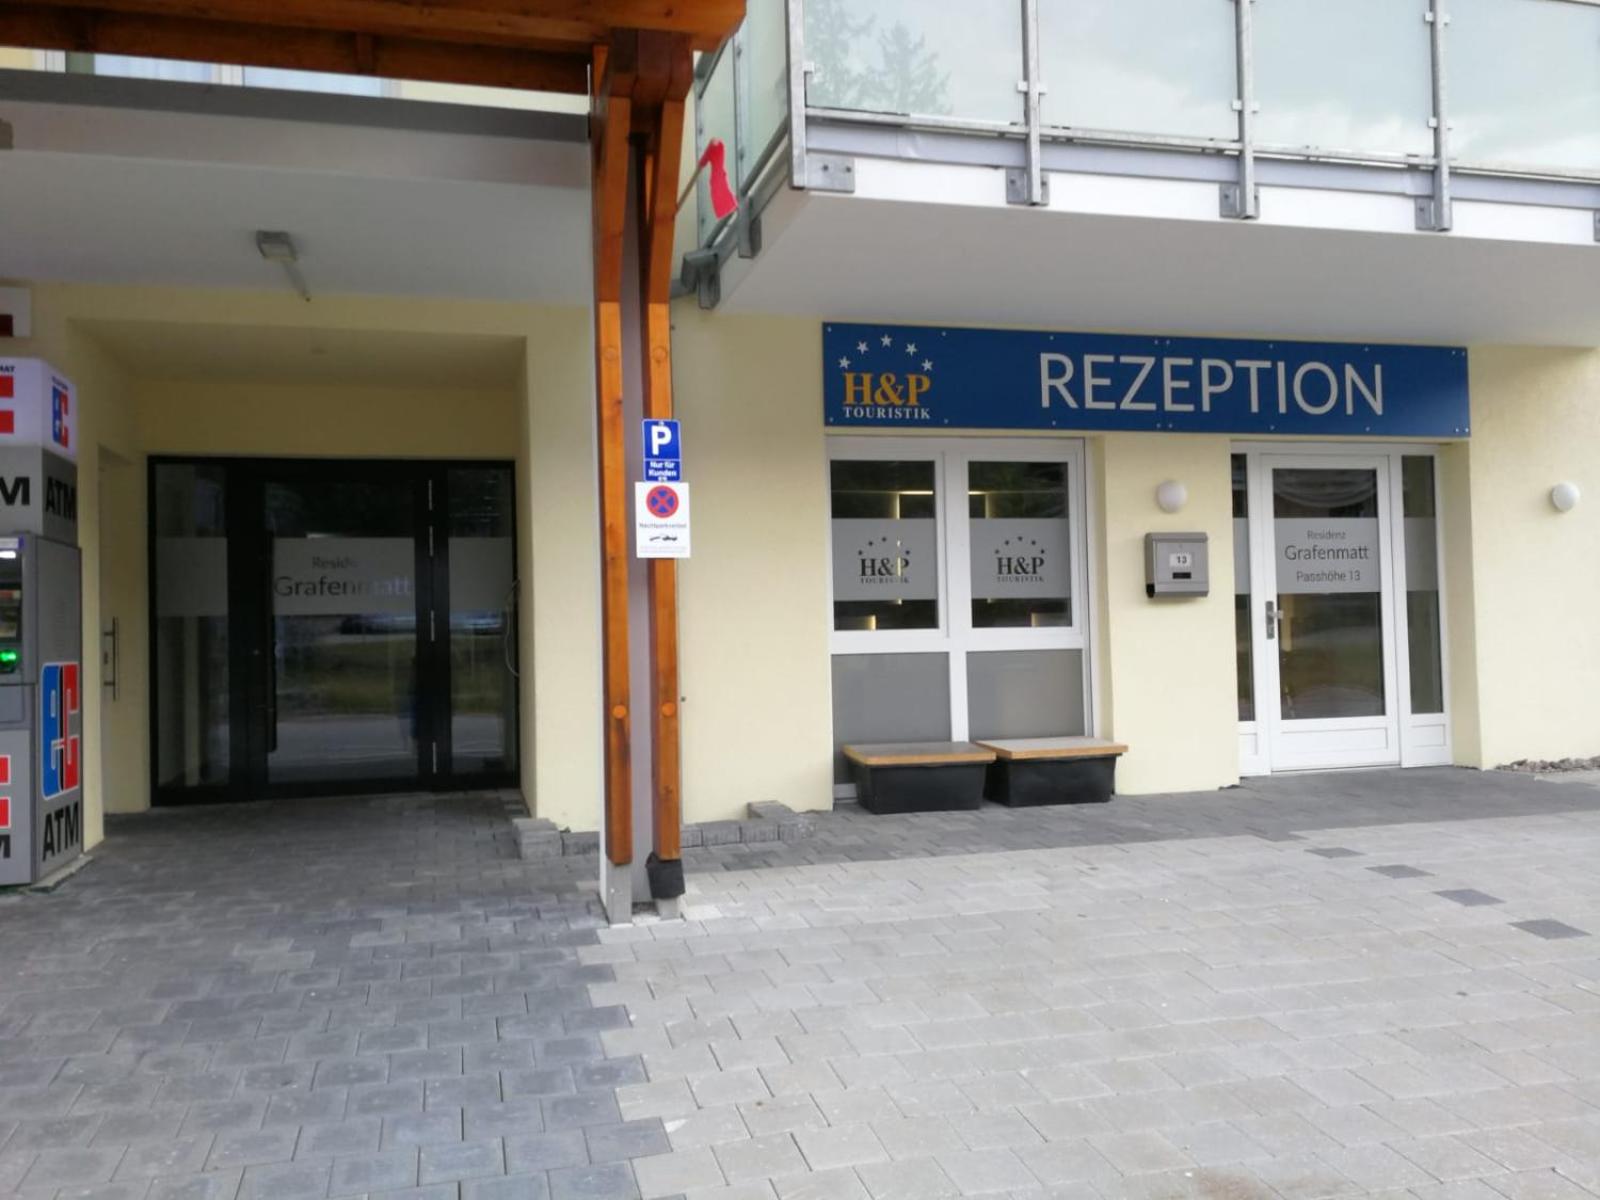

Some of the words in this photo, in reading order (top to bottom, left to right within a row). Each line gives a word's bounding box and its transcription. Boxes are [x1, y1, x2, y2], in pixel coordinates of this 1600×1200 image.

[843, 371, 932, 407] H&P
[1040, 352, 1384, 417] REZEPTION
[843, 406, 931, 420] TOURISTIK
[651, 424, 672, 455] P
[648, 468, 677, 478] Kunden
[45, 476, 77, 522] ATM
[1307, 529, 1346, 540] Residenz
[1176, 555, 1188, 564] 13
[1284, 545, 1369, 561] Grafenmatt
[860, 558, 910, 577] H&P
[997, 557, 1045, 575] H&P
[1296, 569, 1346, 583] Passhöhe
[1349, 569, 1361, 581] 13
[42, 800, 80, 862] ATM
